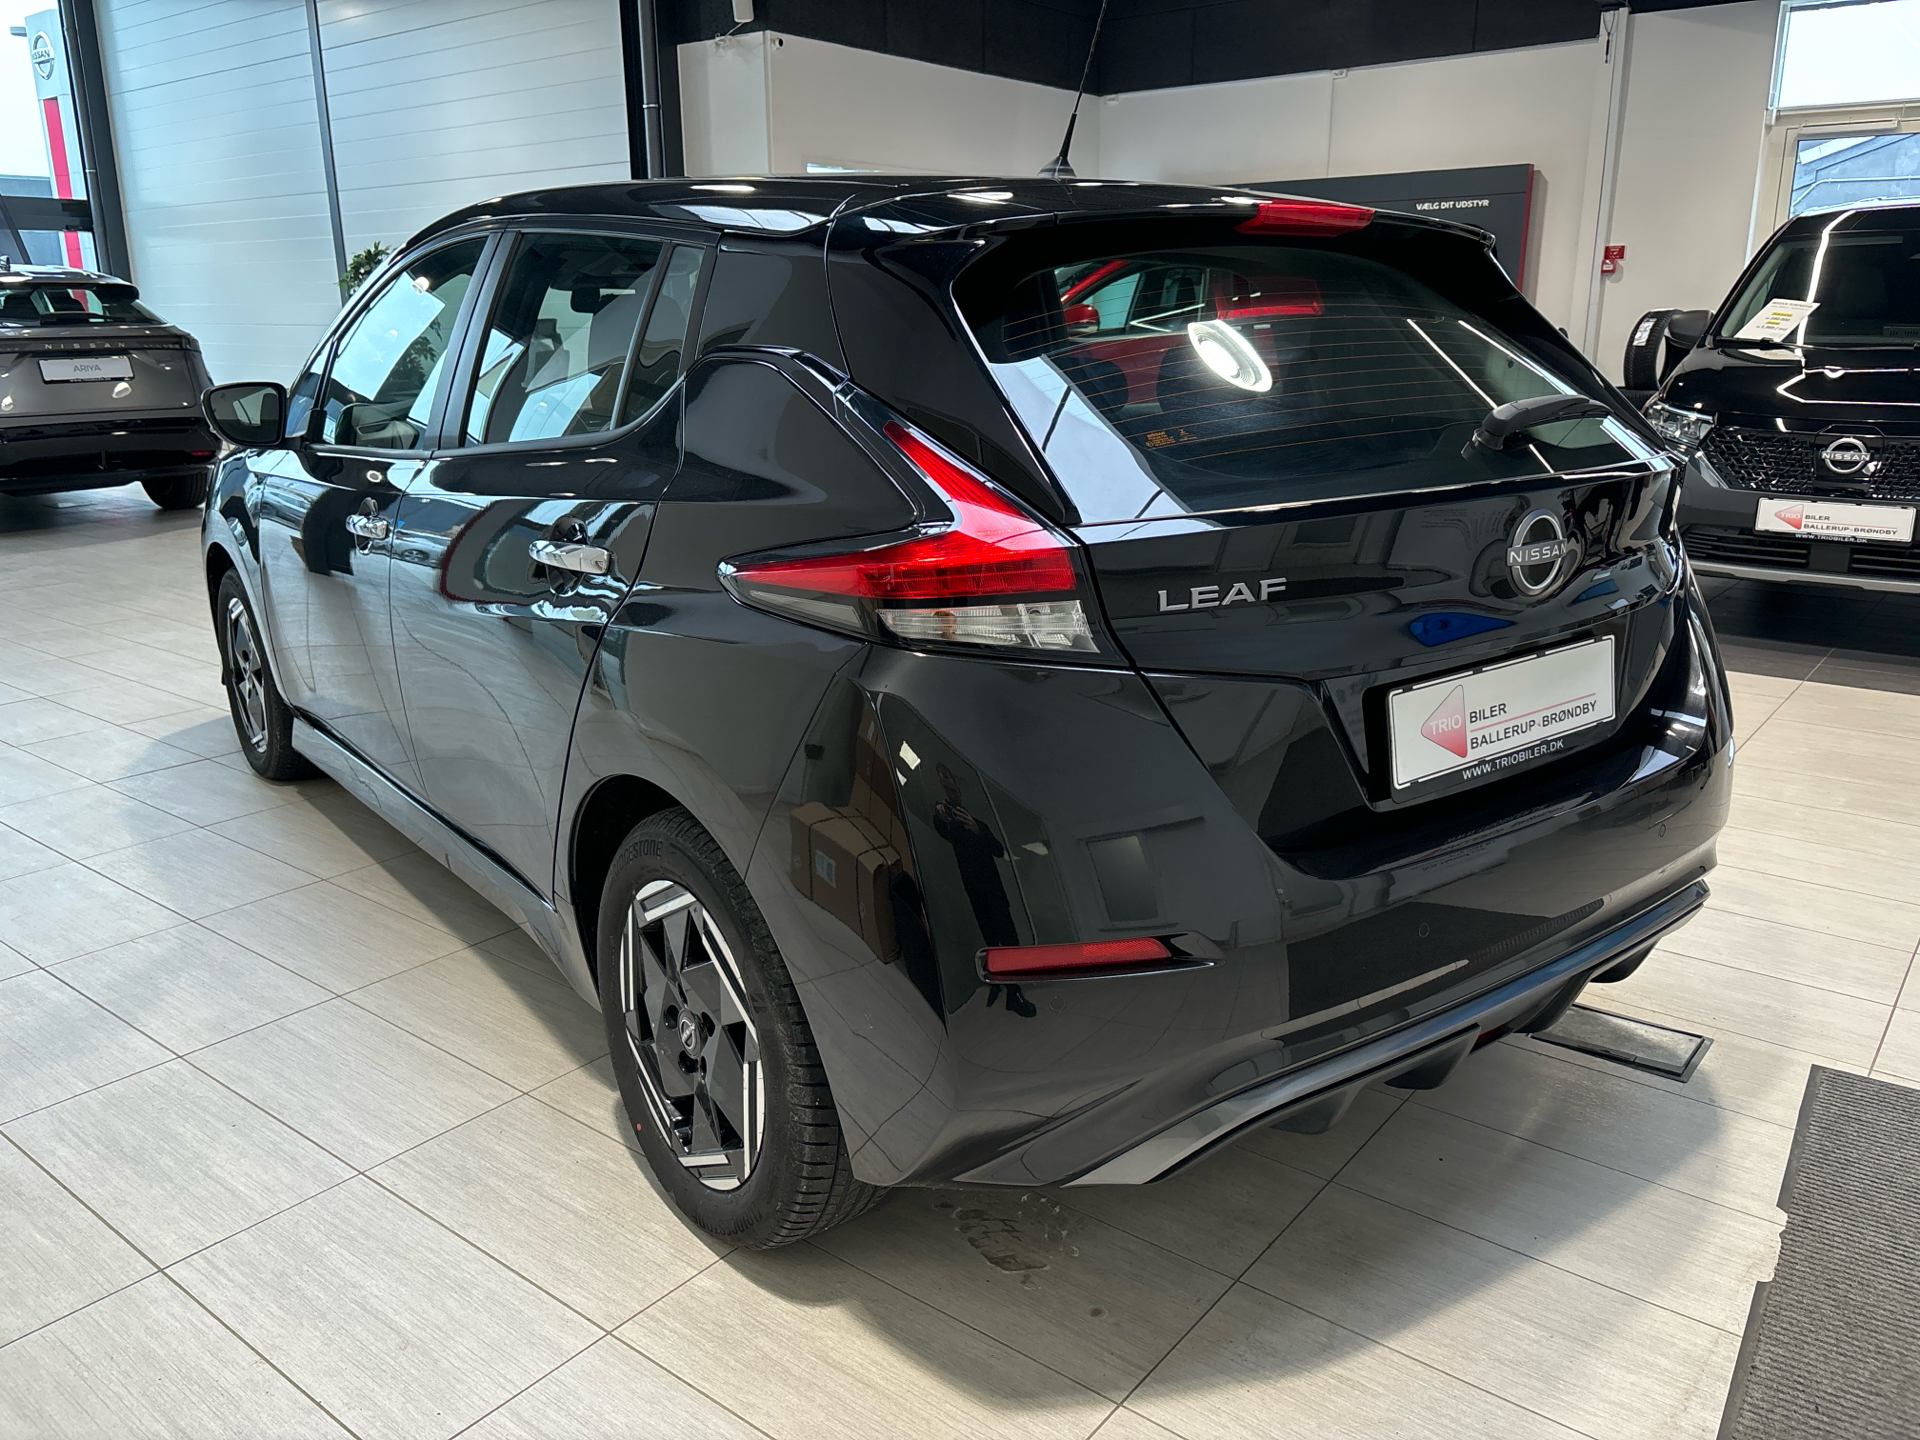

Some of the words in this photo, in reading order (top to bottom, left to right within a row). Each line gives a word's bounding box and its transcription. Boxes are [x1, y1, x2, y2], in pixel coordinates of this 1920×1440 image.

[1416, 202, 1440, 211] VÆLG
[1441, 201, 1454, 209] DIT
[1455, 199, 1490, 208] UDSTYR
[44, 342, 126, 350] NISSAN
[73, 364, 102, 374] ARIYA
[1821, 452, 1870, 461] NISSAN
[1804, 514, 1831, 522] BILER
[1795, 533, 1868, 544] WWW.TRIOBILER.DK
[1509, 541, 1567, 564] NISSAN
[1157, 577, 1288, 612] LEAF
[1429, 714, 1462, 735] TRIO
[1469, 702, 1508, 724] BILER
[1462, 738, 1565, 780] WWW.TRIOBILER.DK
